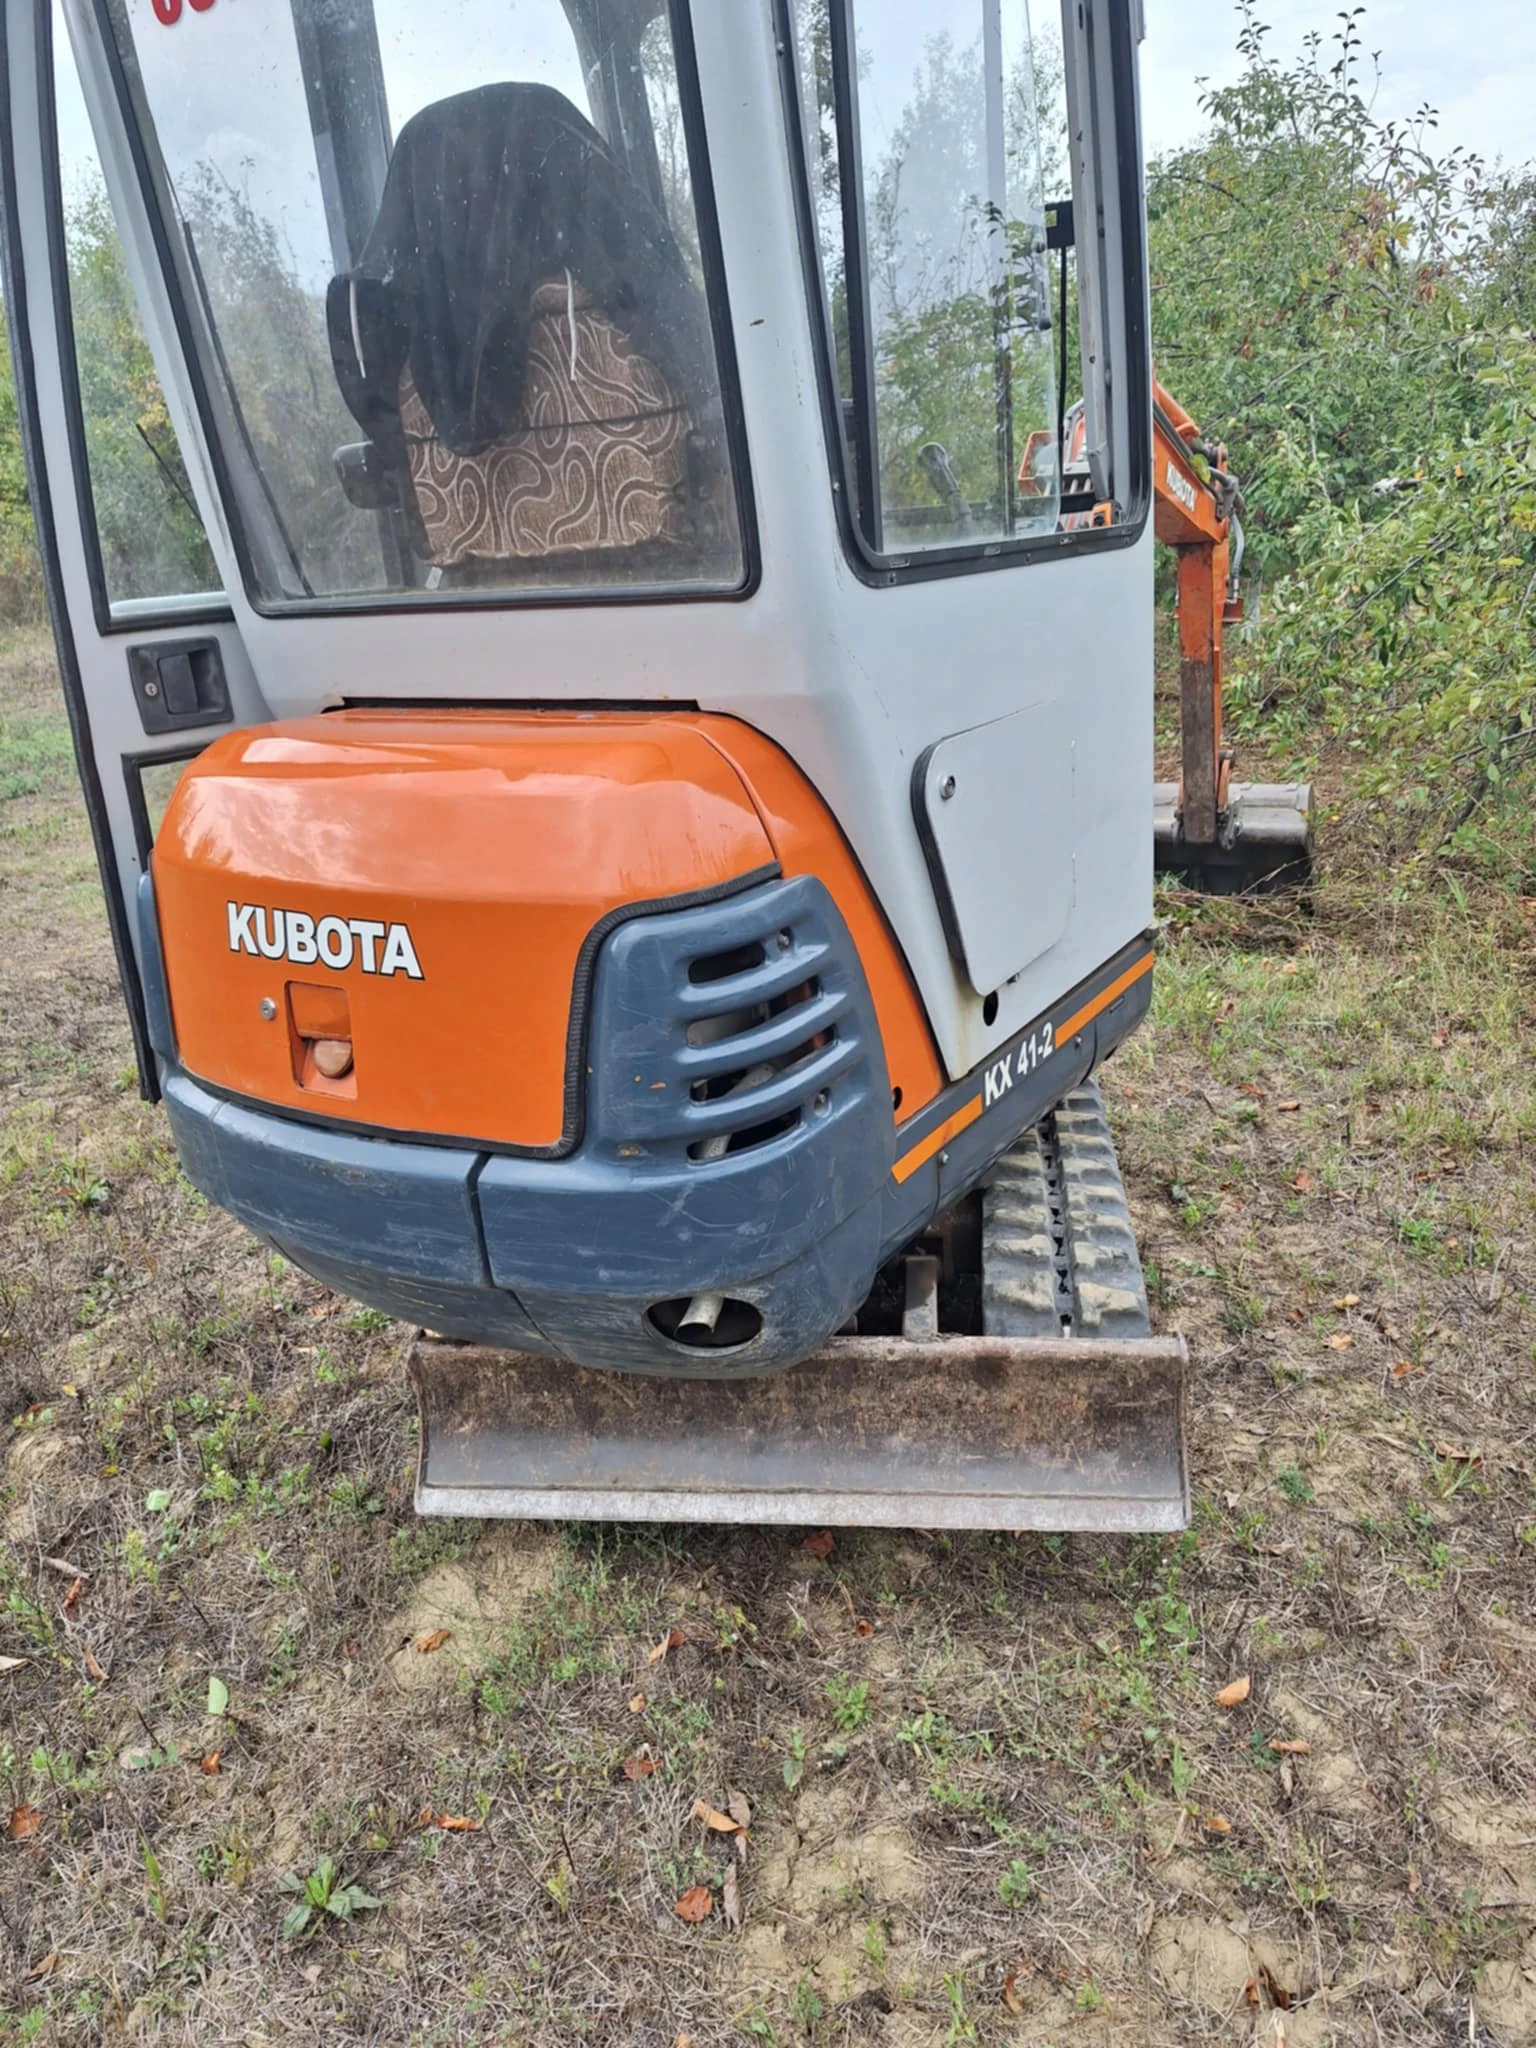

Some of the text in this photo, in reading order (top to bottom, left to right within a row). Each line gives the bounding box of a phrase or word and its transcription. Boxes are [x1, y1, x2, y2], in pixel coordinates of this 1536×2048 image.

[227, 900, 425, 980] KUBOTA
[984, 1022, 1053, 1107] KX 41-2
